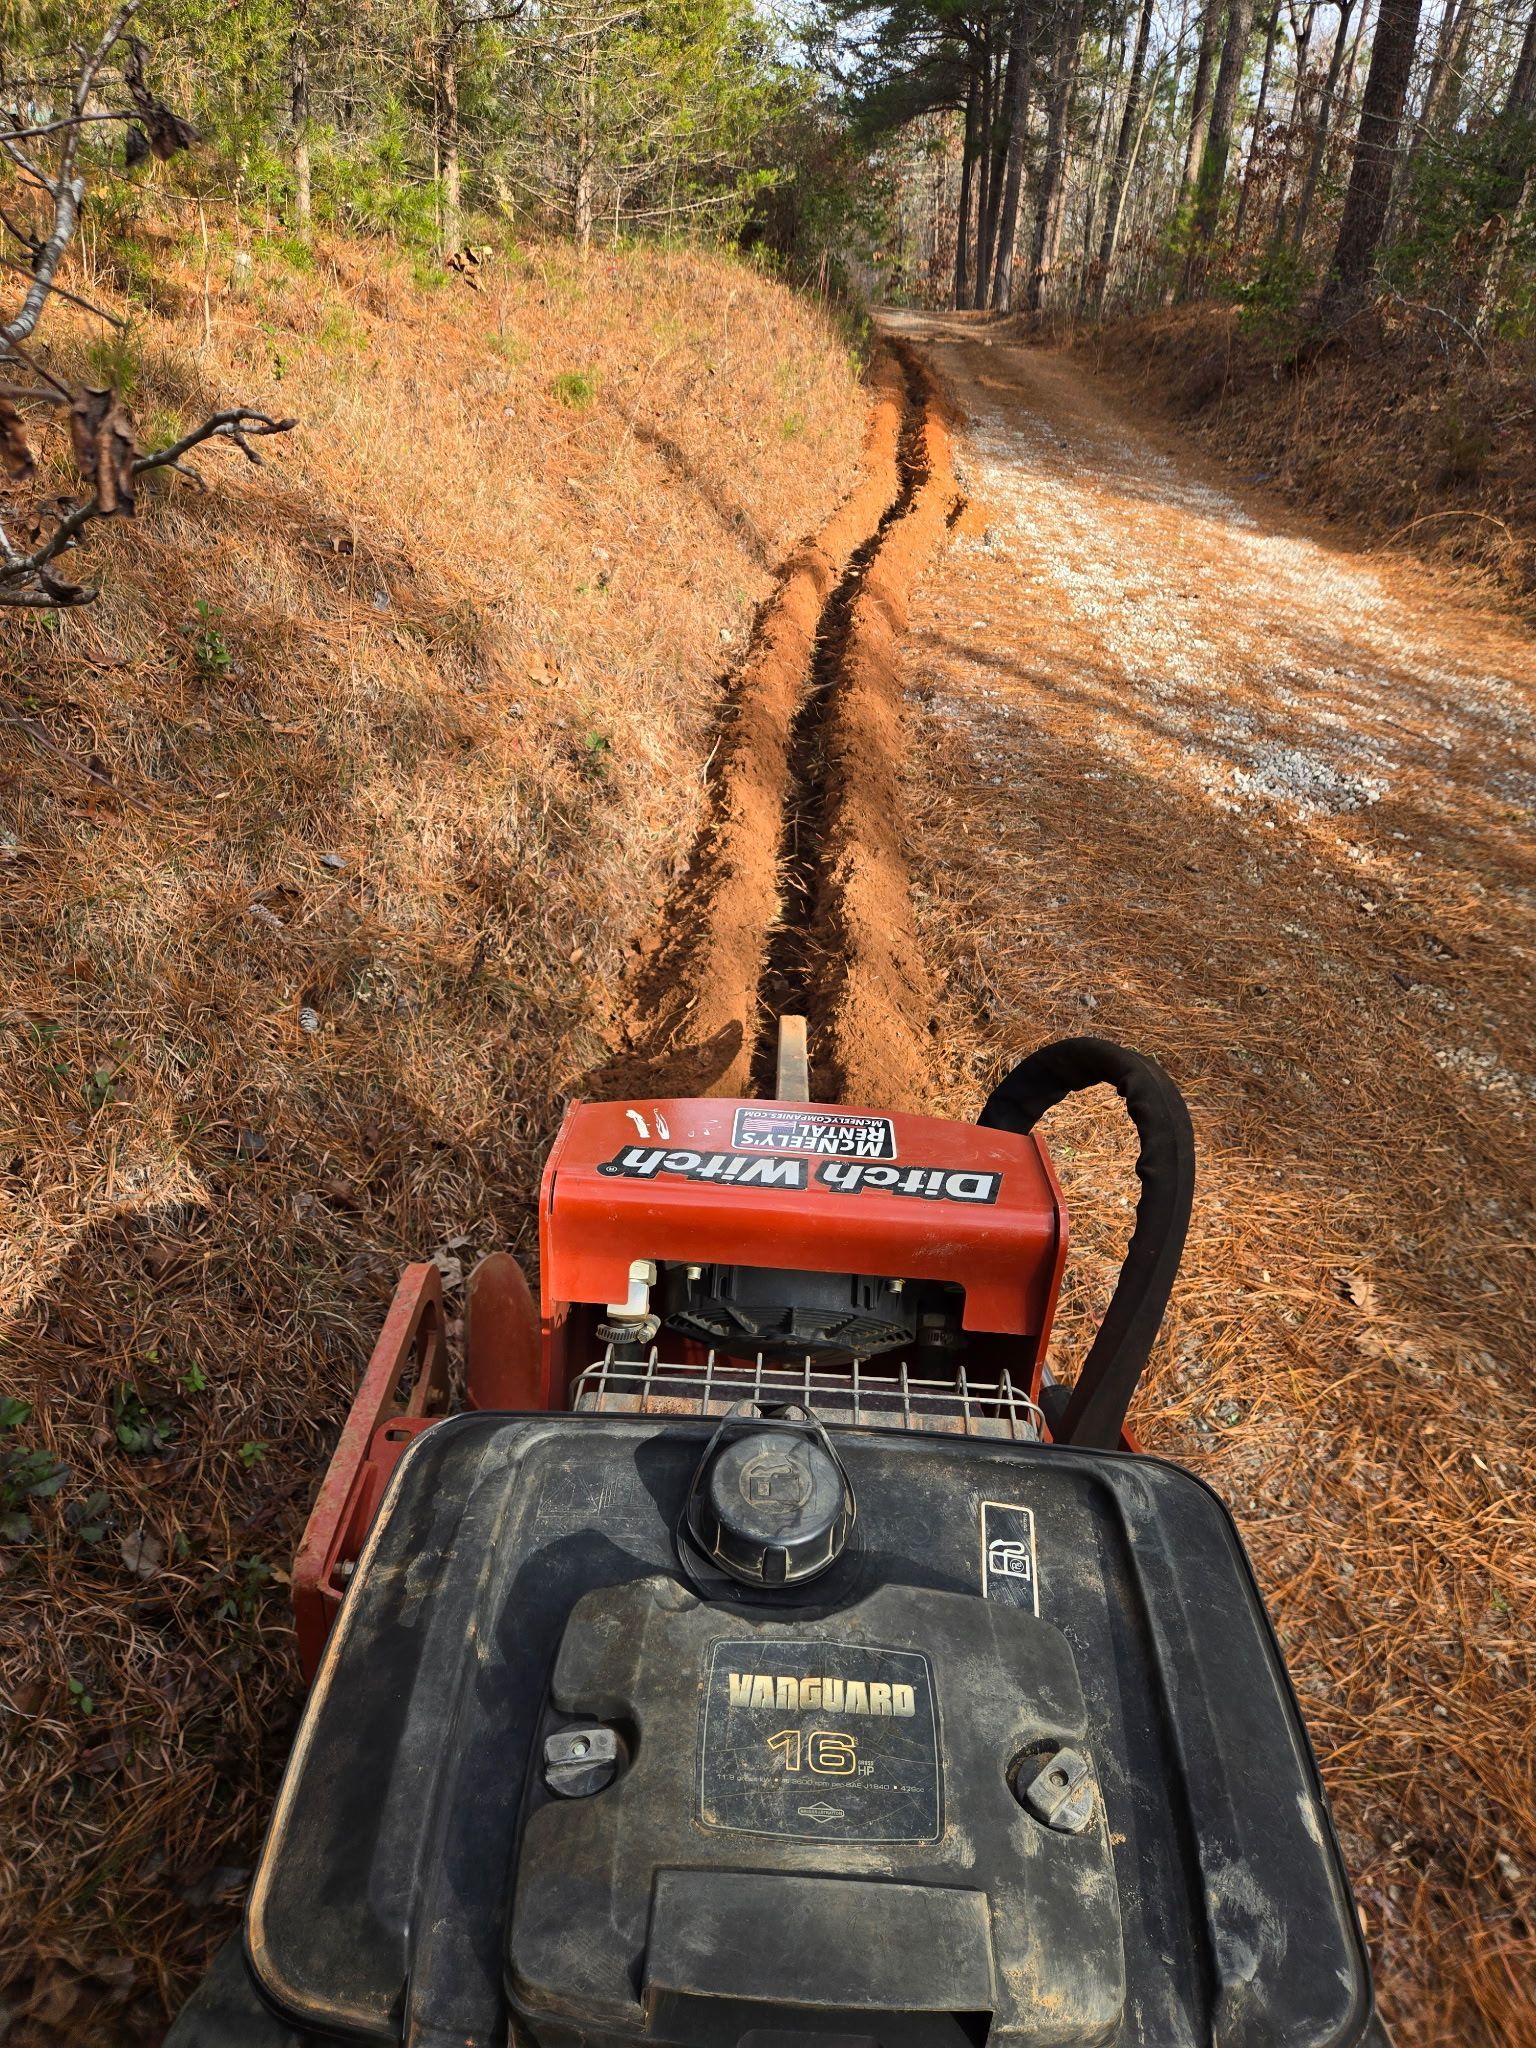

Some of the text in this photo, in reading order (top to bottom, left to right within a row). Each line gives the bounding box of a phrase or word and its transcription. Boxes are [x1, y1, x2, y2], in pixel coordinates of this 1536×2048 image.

[799, 1124, 886, 1142] RENTAL
[823, 1162, 995, 1200] Ditch
[728, 1673, 916, 1718] VANGUARD
[766, 1730, 857, 1775] 16
[858, 1766, 875, 1776] HP
